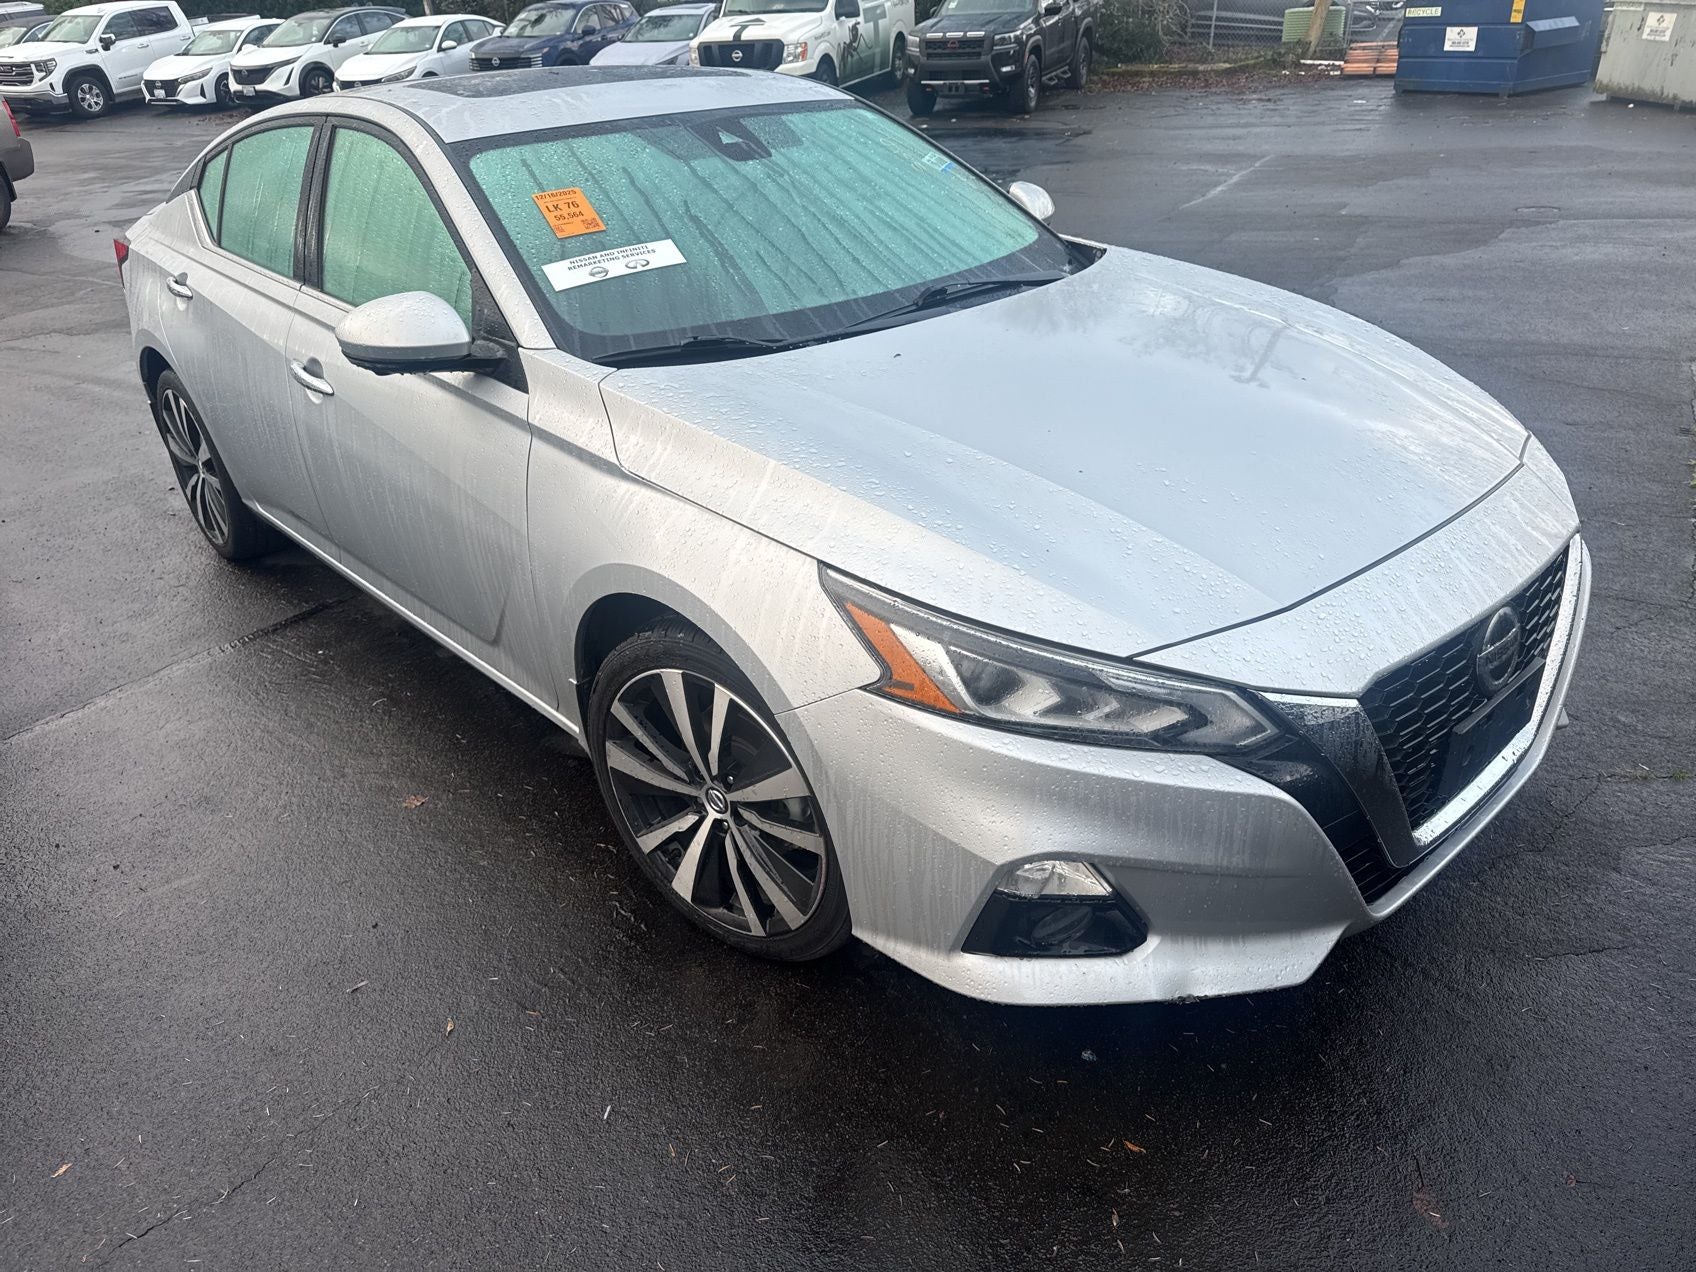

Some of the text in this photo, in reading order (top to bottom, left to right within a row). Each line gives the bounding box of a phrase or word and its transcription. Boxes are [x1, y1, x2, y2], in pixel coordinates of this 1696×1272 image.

[545, 200, 580, 213] LK 76
[567, 248, 657, 271] REMARKETING SERVICES
[569, 245, 649, 265] NISSAN AND INFINITI
